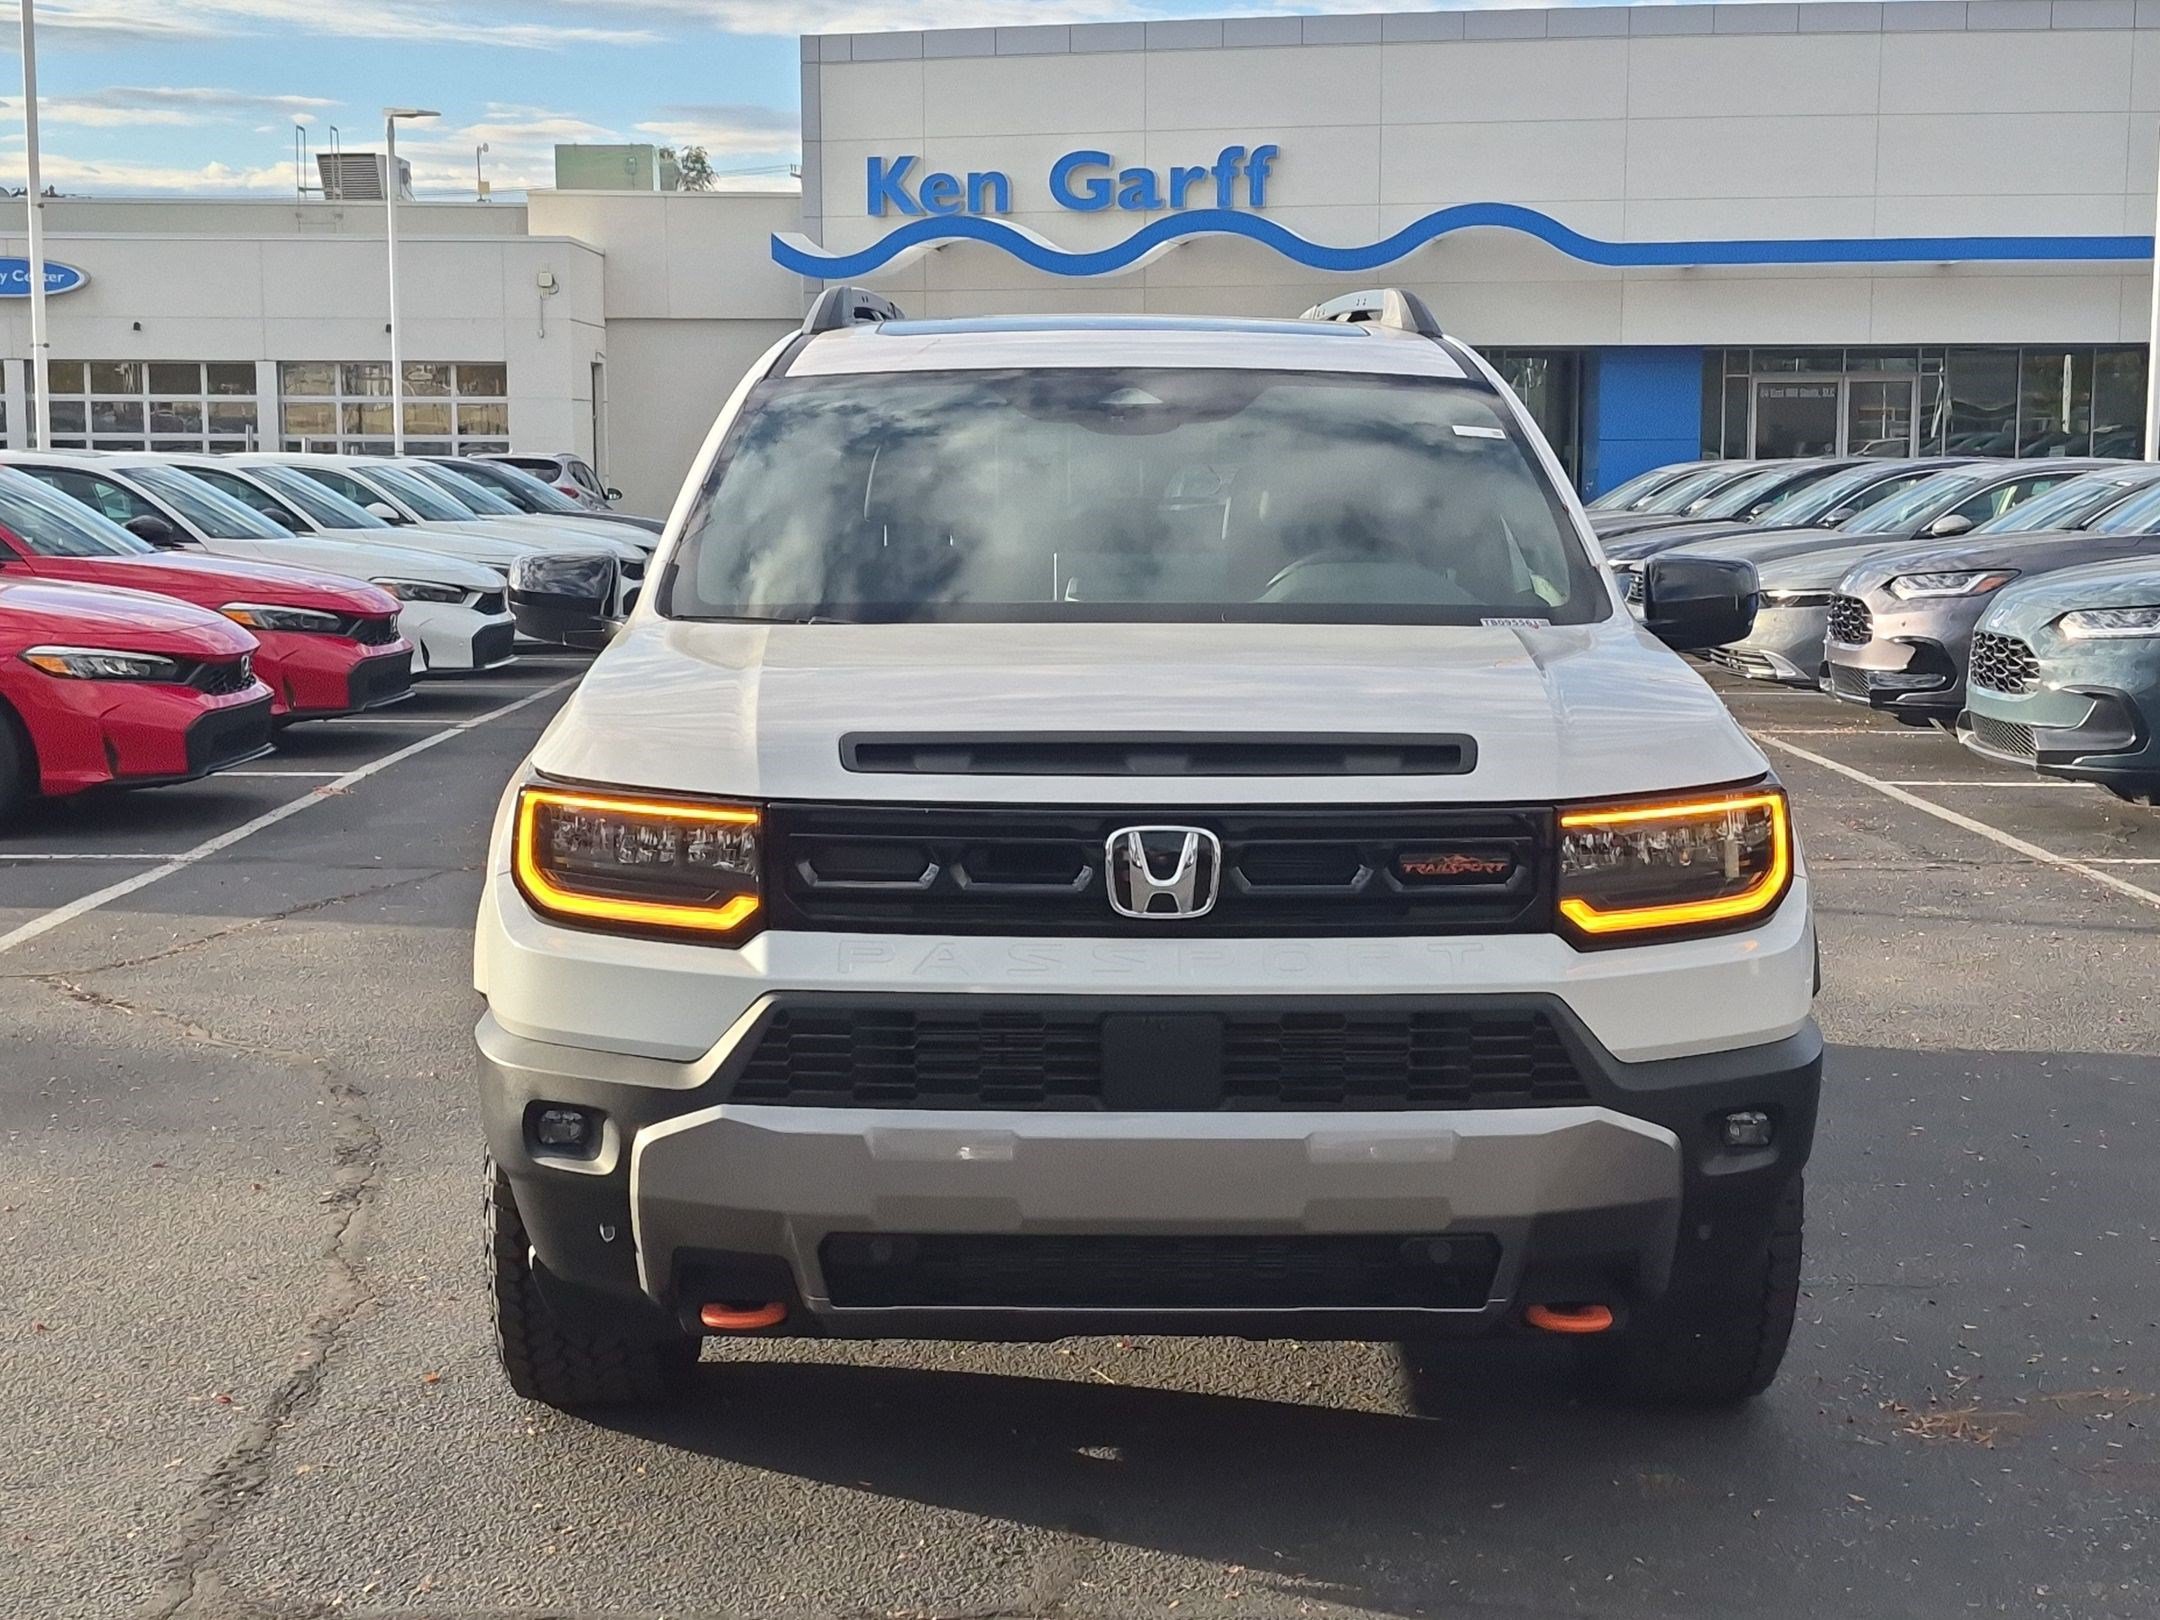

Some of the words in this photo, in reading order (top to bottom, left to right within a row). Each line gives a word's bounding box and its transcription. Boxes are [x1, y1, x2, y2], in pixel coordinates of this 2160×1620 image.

[866, 154, 1014, 217] Ken
[1049, 144, 1280, 212] Garff
[837, 940, 1484, 977] PASSPORT
